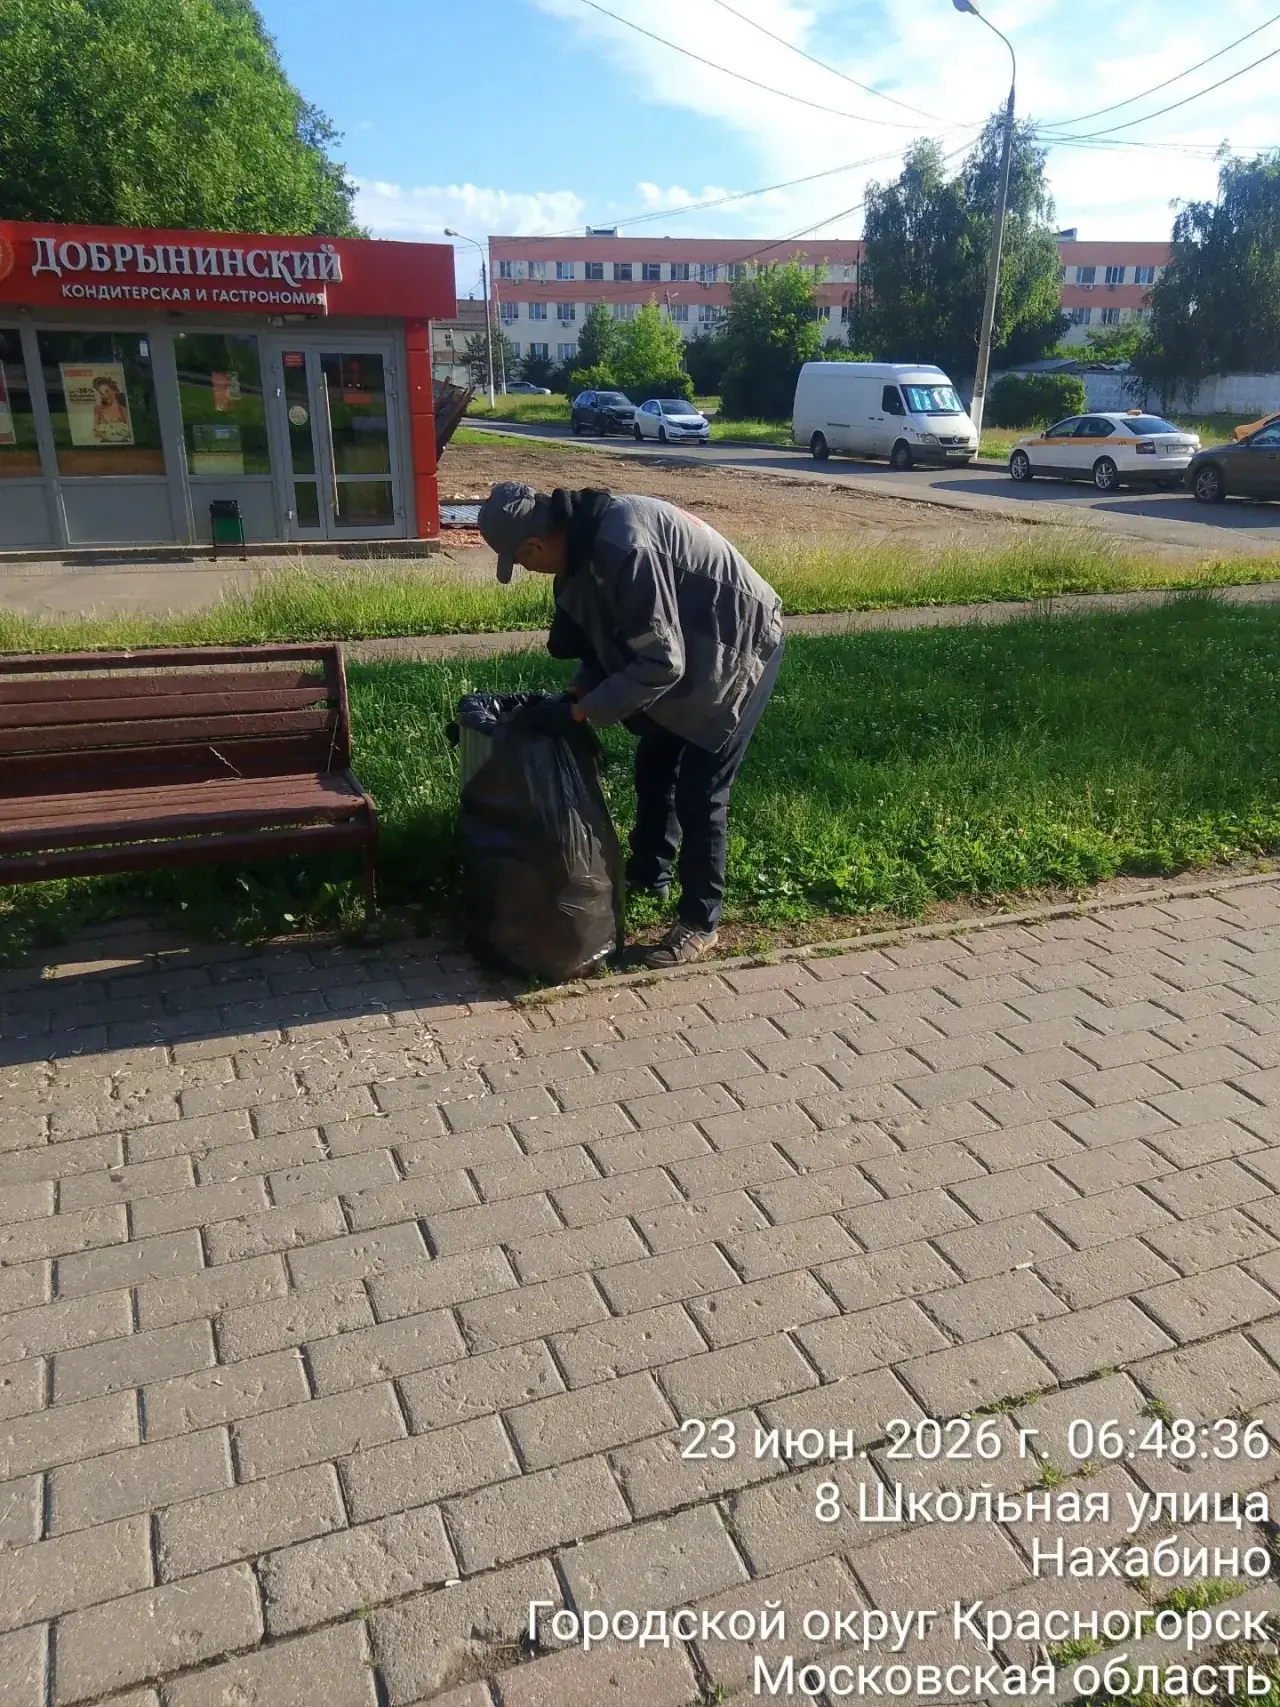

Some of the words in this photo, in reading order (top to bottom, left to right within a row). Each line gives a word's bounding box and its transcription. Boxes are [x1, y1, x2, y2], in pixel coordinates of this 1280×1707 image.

[32, 237, 342, 287] ДОБРЫНИНСКИЙ
[61, 284, 190, 302] КОНДИТЕРСКАЯ
[196, 289, 207, 301] И
[212, 289, 326, 306] ГАСТРОНОМИЯ
